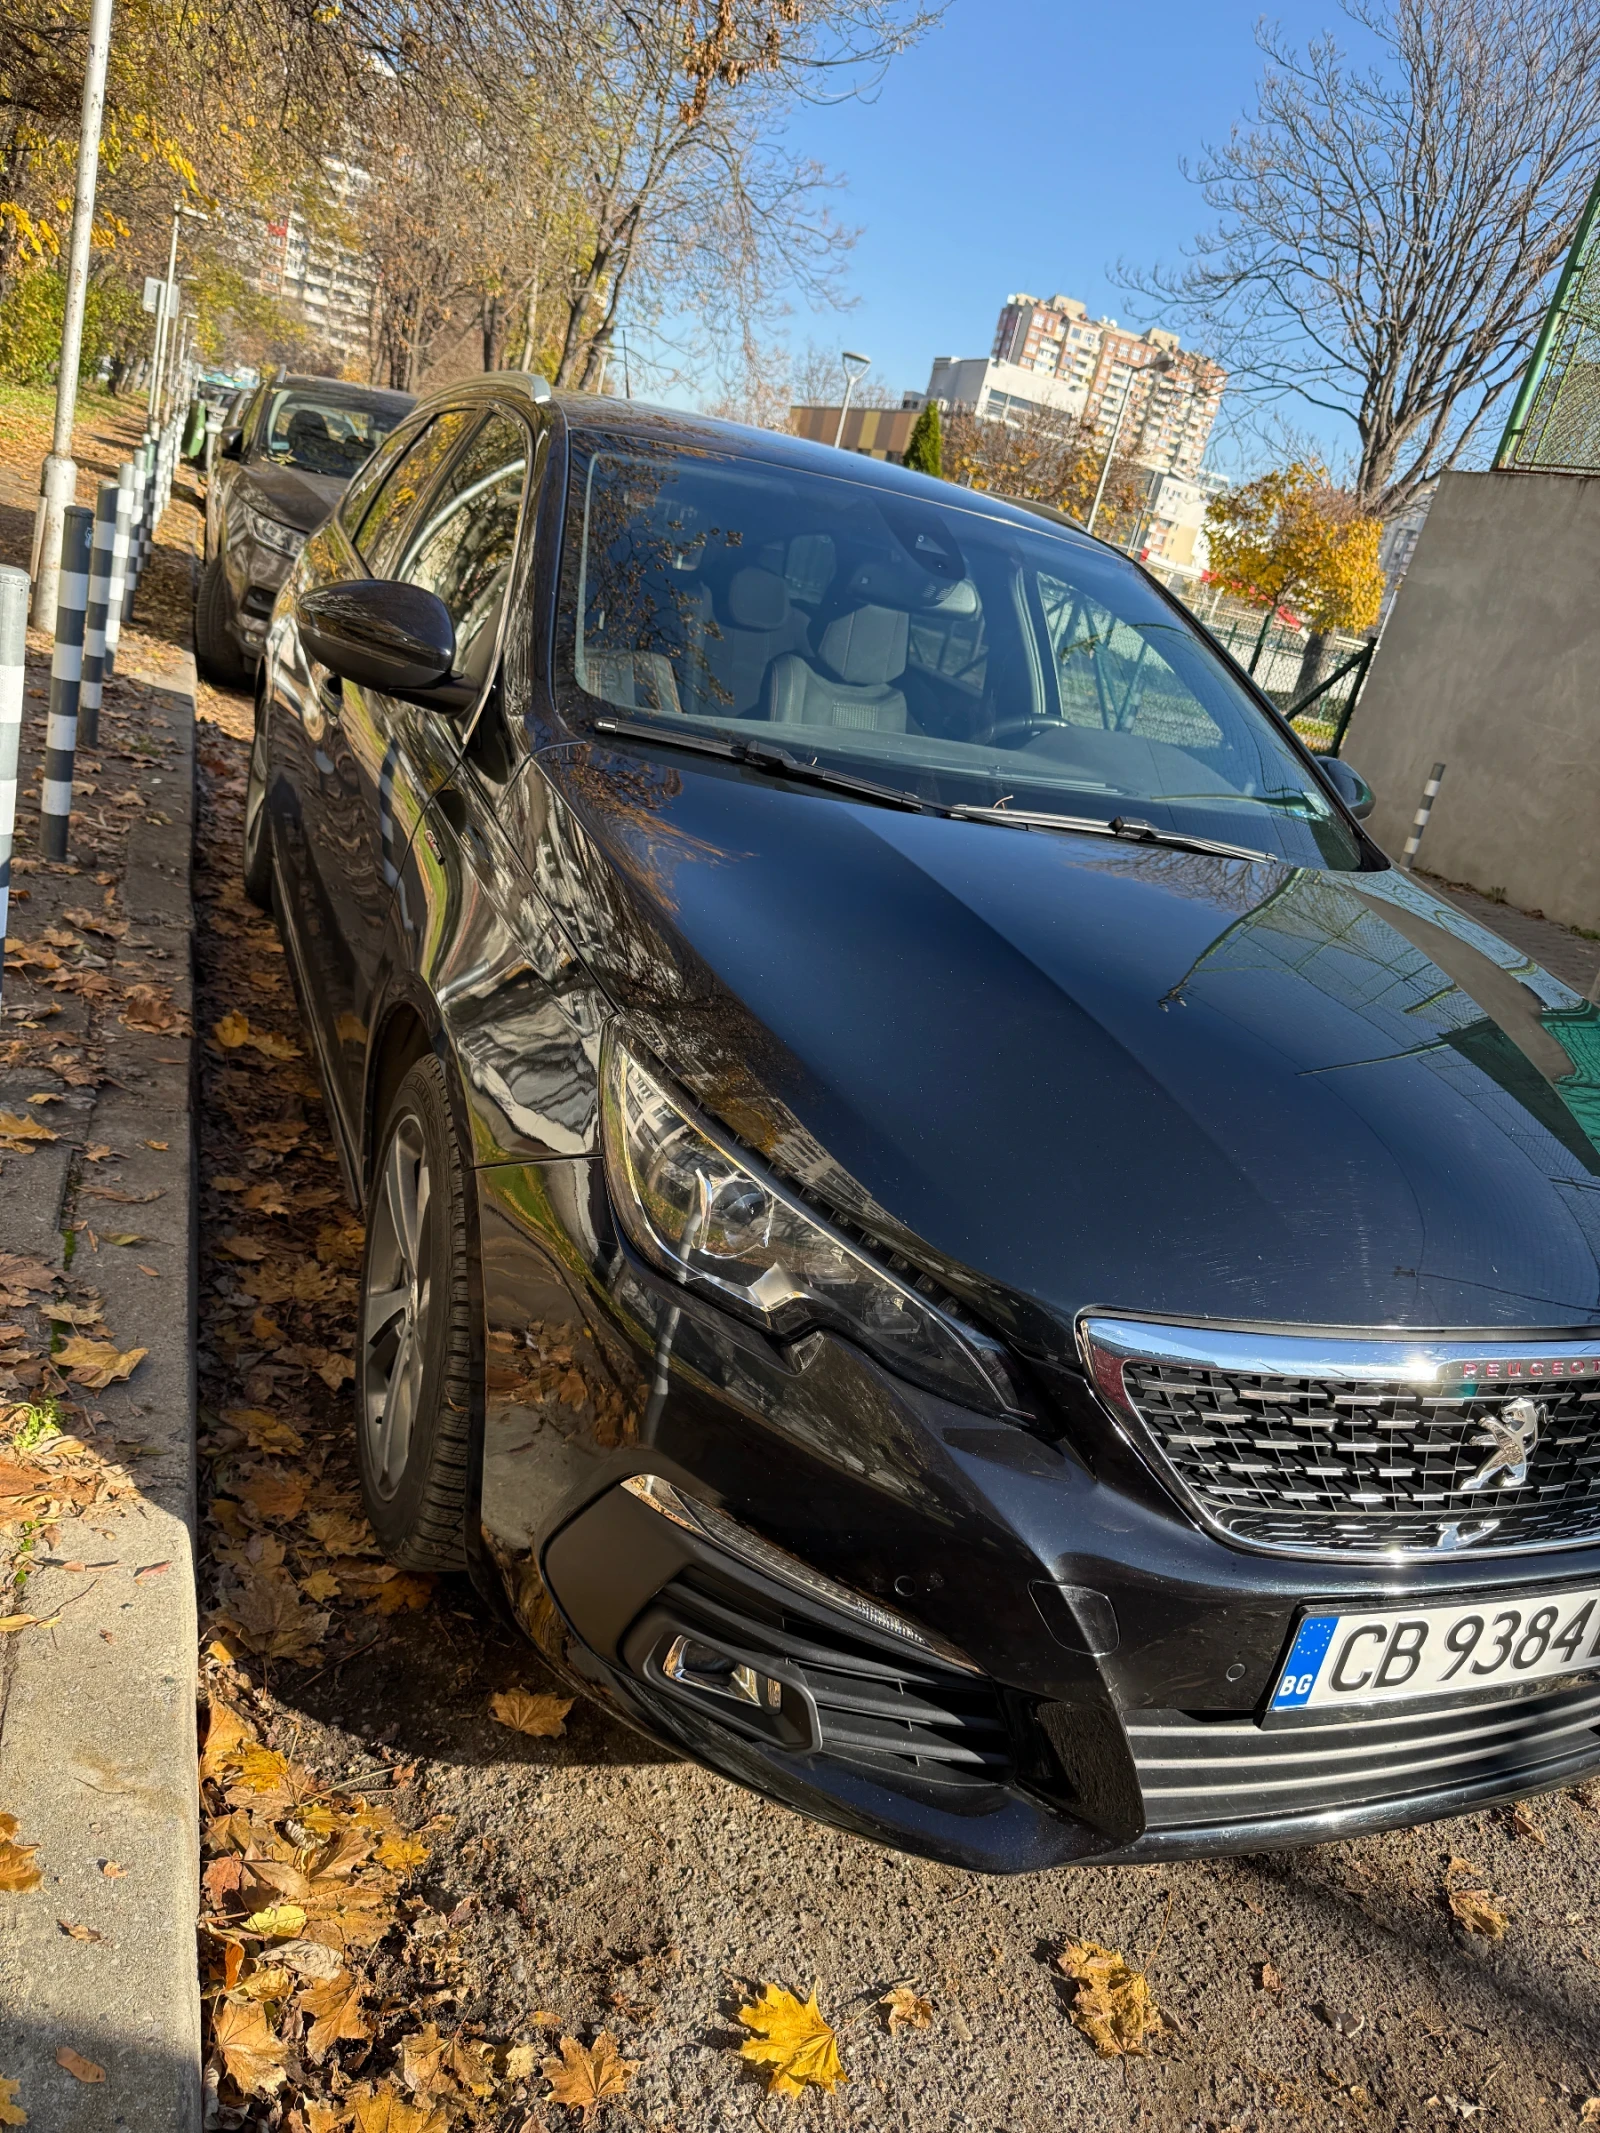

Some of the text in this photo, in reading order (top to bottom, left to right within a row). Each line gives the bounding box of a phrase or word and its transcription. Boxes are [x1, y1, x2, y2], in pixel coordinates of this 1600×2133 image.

[1463, 1359, 1600, 1378] PEUGEOT
[1328, 1617, 1429, 1692] CB
[1279, 1674, 1313, 1696] BG
